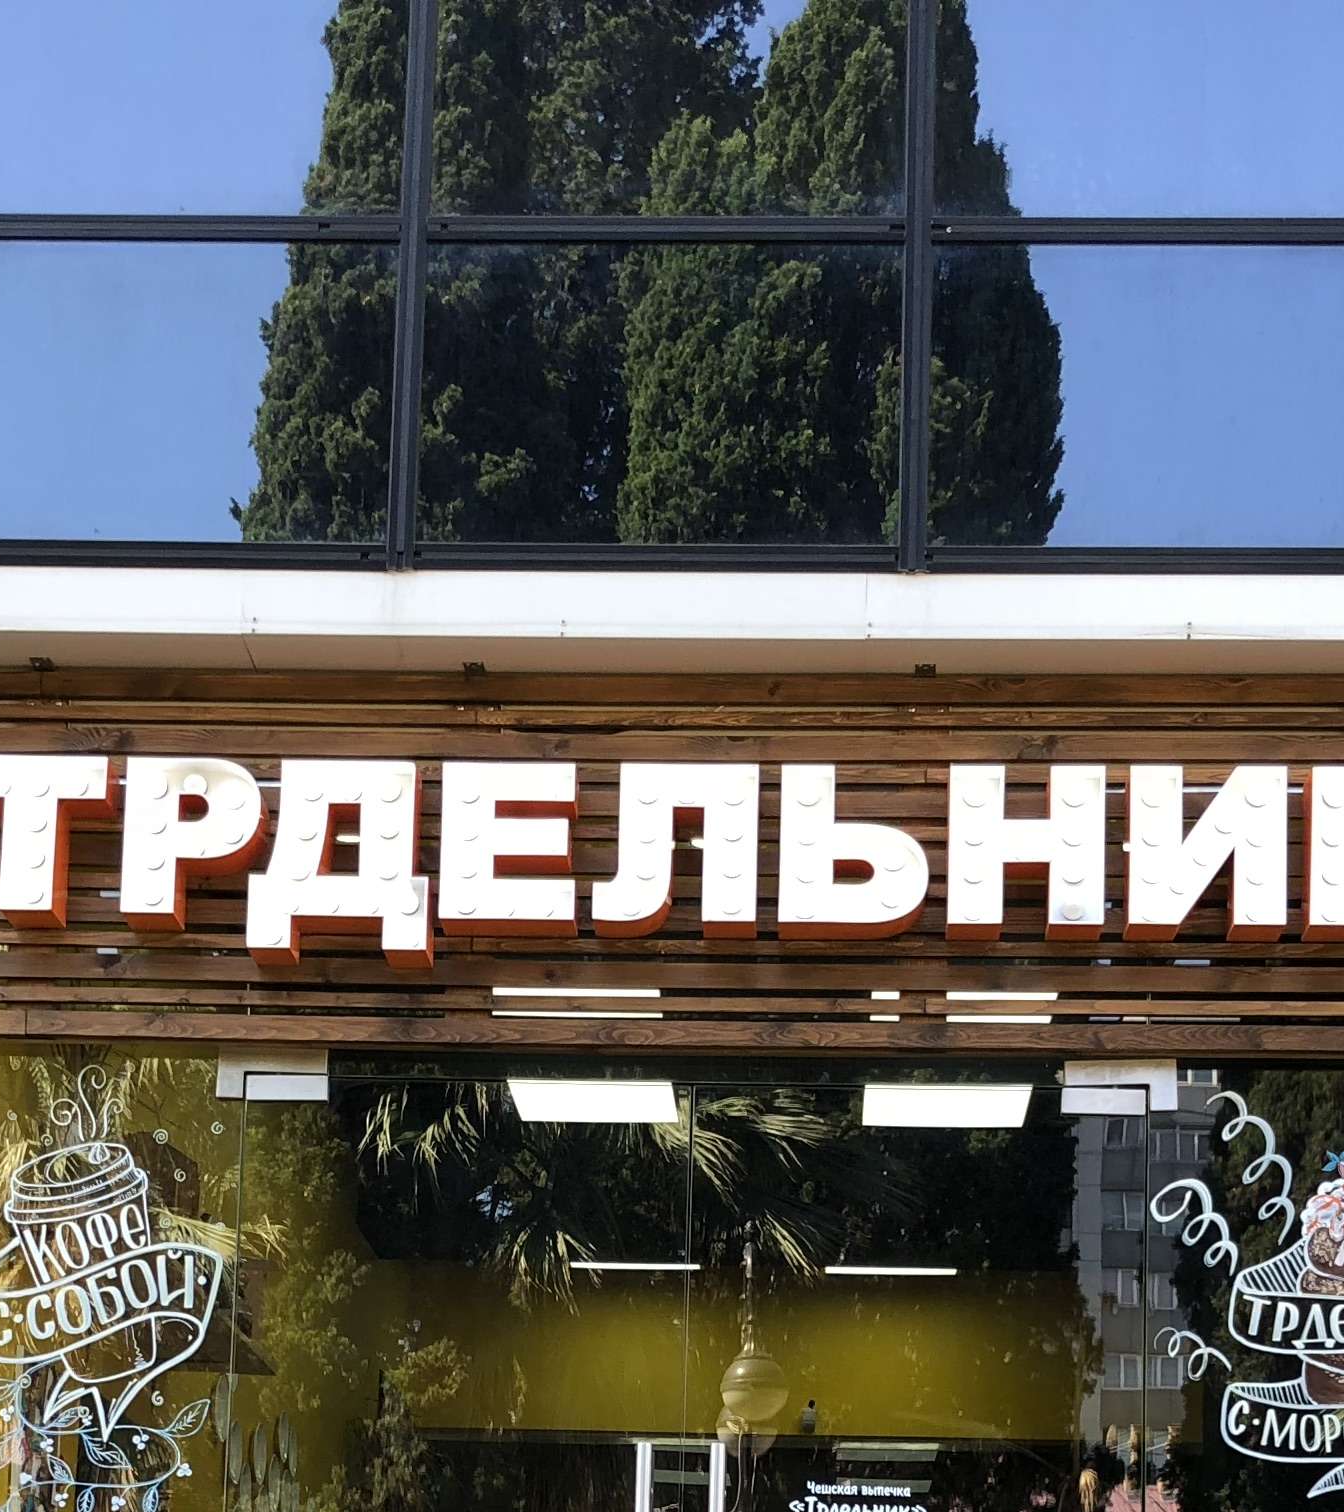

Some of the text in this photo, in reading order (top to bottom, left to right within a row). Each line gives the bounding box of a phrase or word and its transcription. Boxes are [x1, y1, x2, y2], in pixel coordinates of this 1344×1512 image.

[21, 1204, 148, 1284] КОФЕ
[25, 1248, 195, 1341] СОБОЙ
[806, 1480, 858, 1496] Чешская
